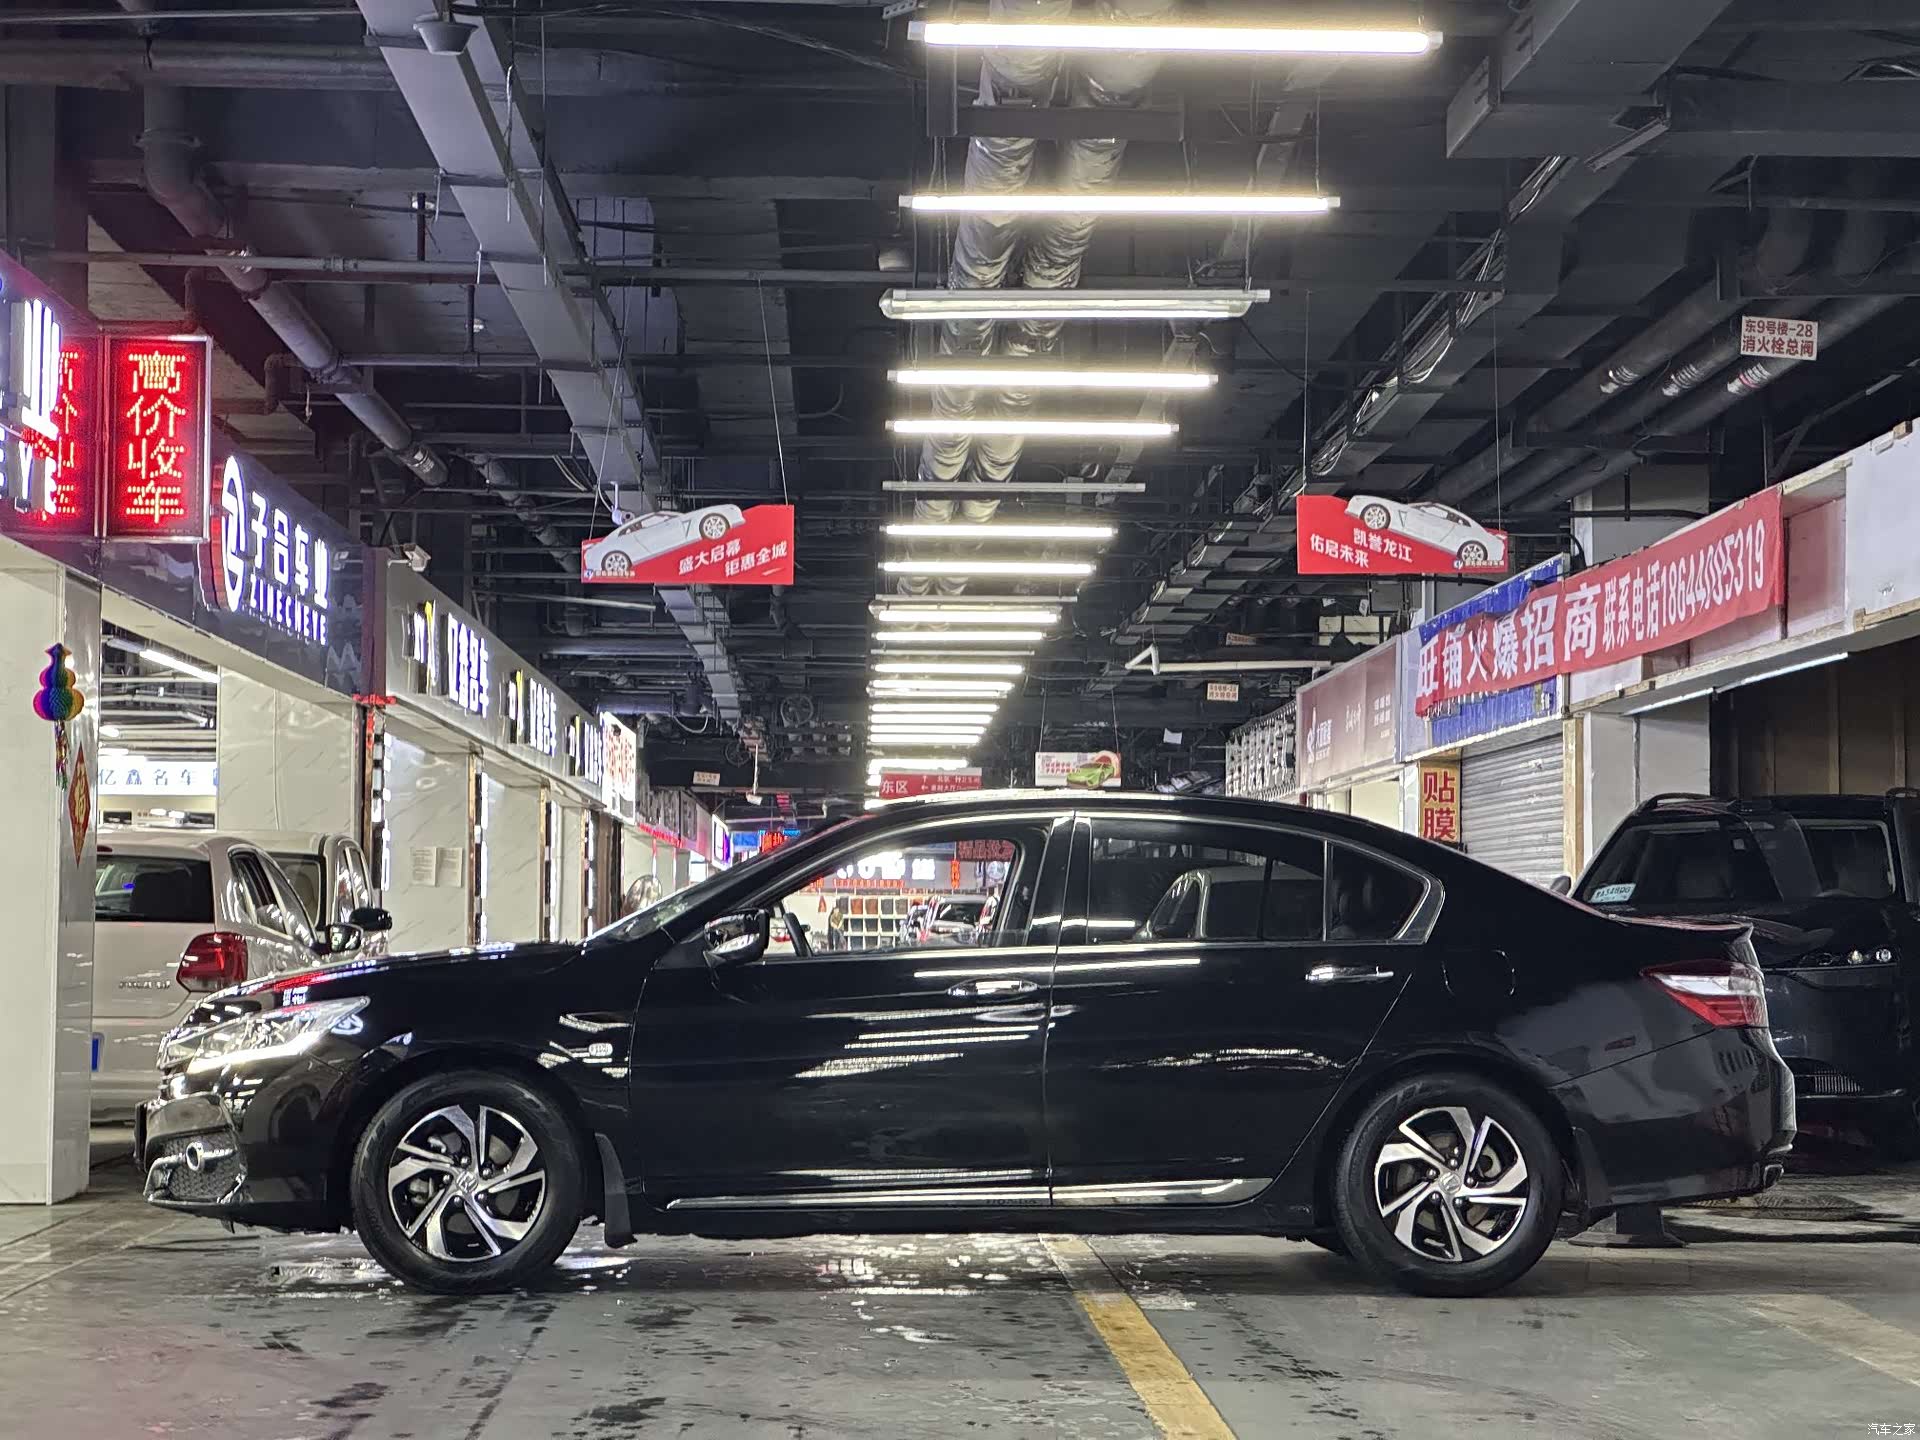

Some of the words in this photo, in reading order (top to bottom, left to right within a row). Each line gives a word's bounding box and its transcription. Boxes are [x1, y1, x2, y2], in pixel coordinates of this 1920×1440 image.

[1742, 335, 1814, 357] 消火栓总阀
[1745, 319, 1813, 338] 东9号楼-28
[126, 350, 186, 524] 高价收车
[678, 538, 741, 576] 盛大启幕
[724, 540, 788, 577] 钜惠全城
[1310, 533, 1369, 568] 佑启未来
[1353, 527, 1412, 563] 凯誉龙江
[881, 779, 909, 795] 东区
[1423, 771, 1456, 842] 贴膜
